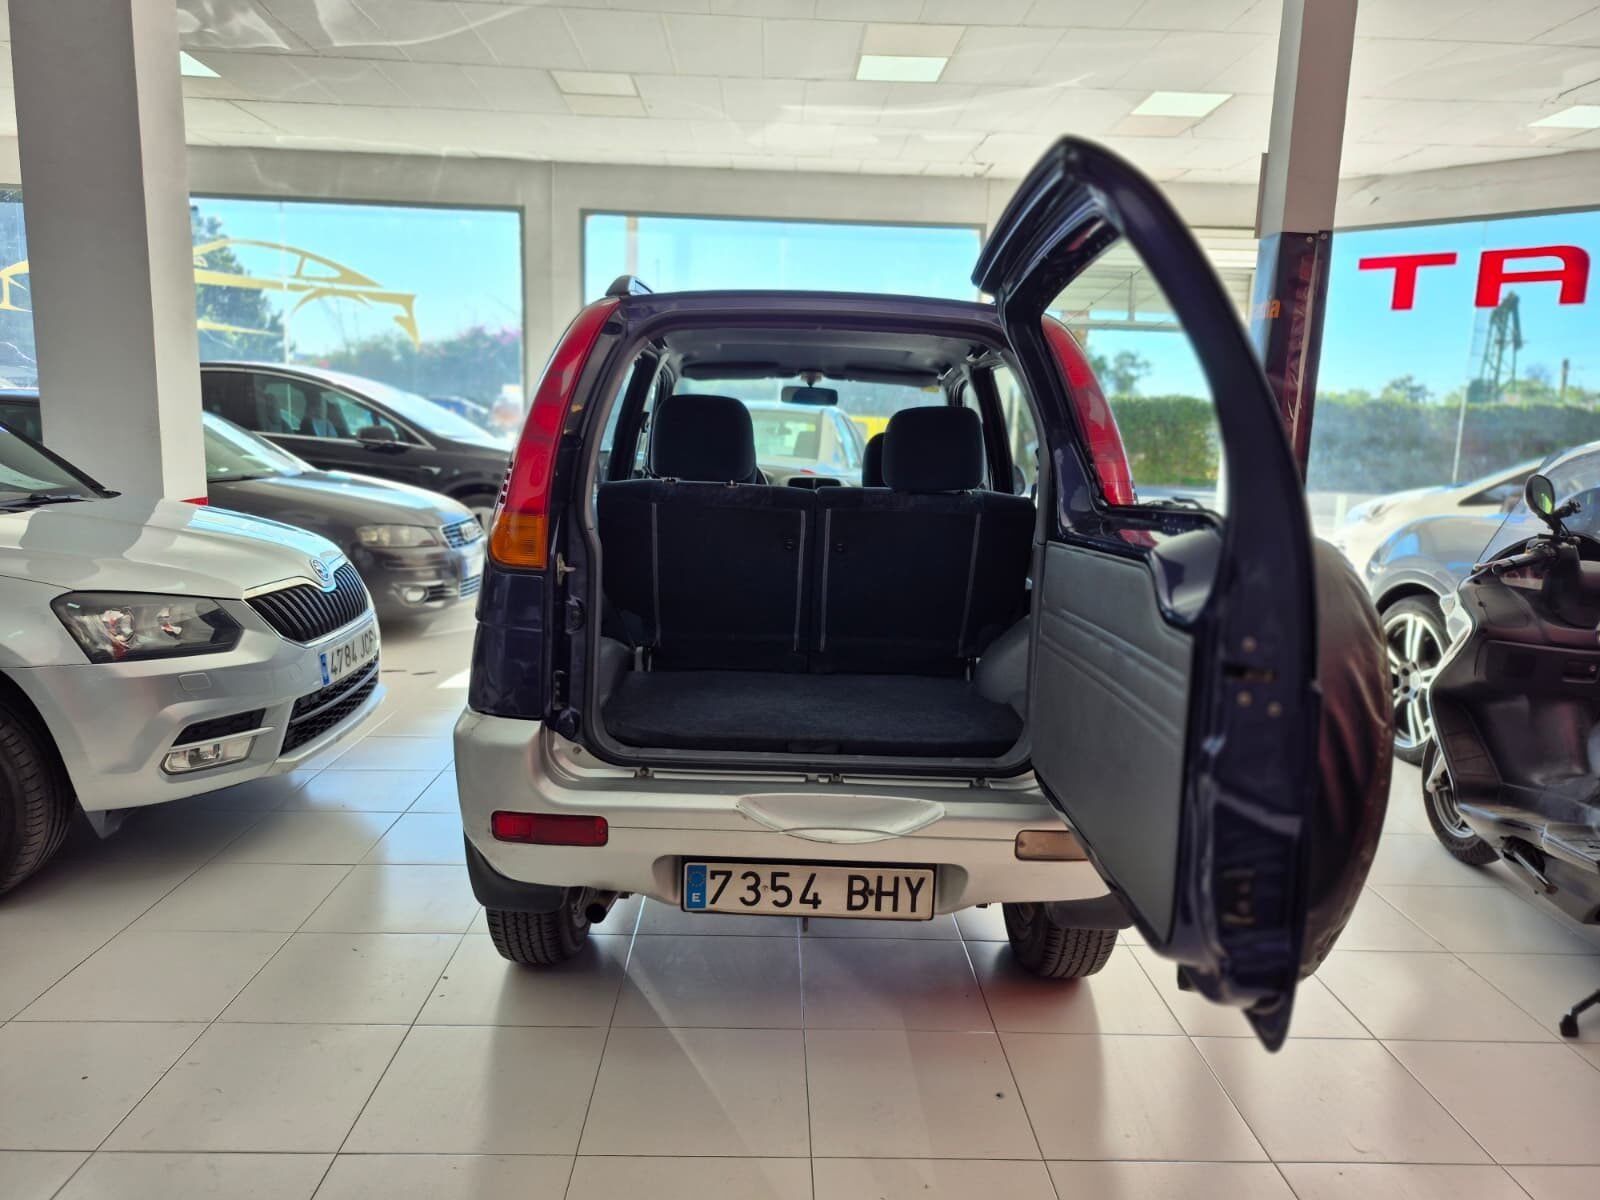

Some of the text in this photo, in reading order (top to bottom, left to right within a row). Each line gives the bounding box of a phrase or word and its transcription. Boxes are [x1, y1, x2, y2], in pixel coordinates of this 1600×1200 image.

[330, 639, 357, 675] 4784
[691, 870, 926, 912] E 7354 BHY
